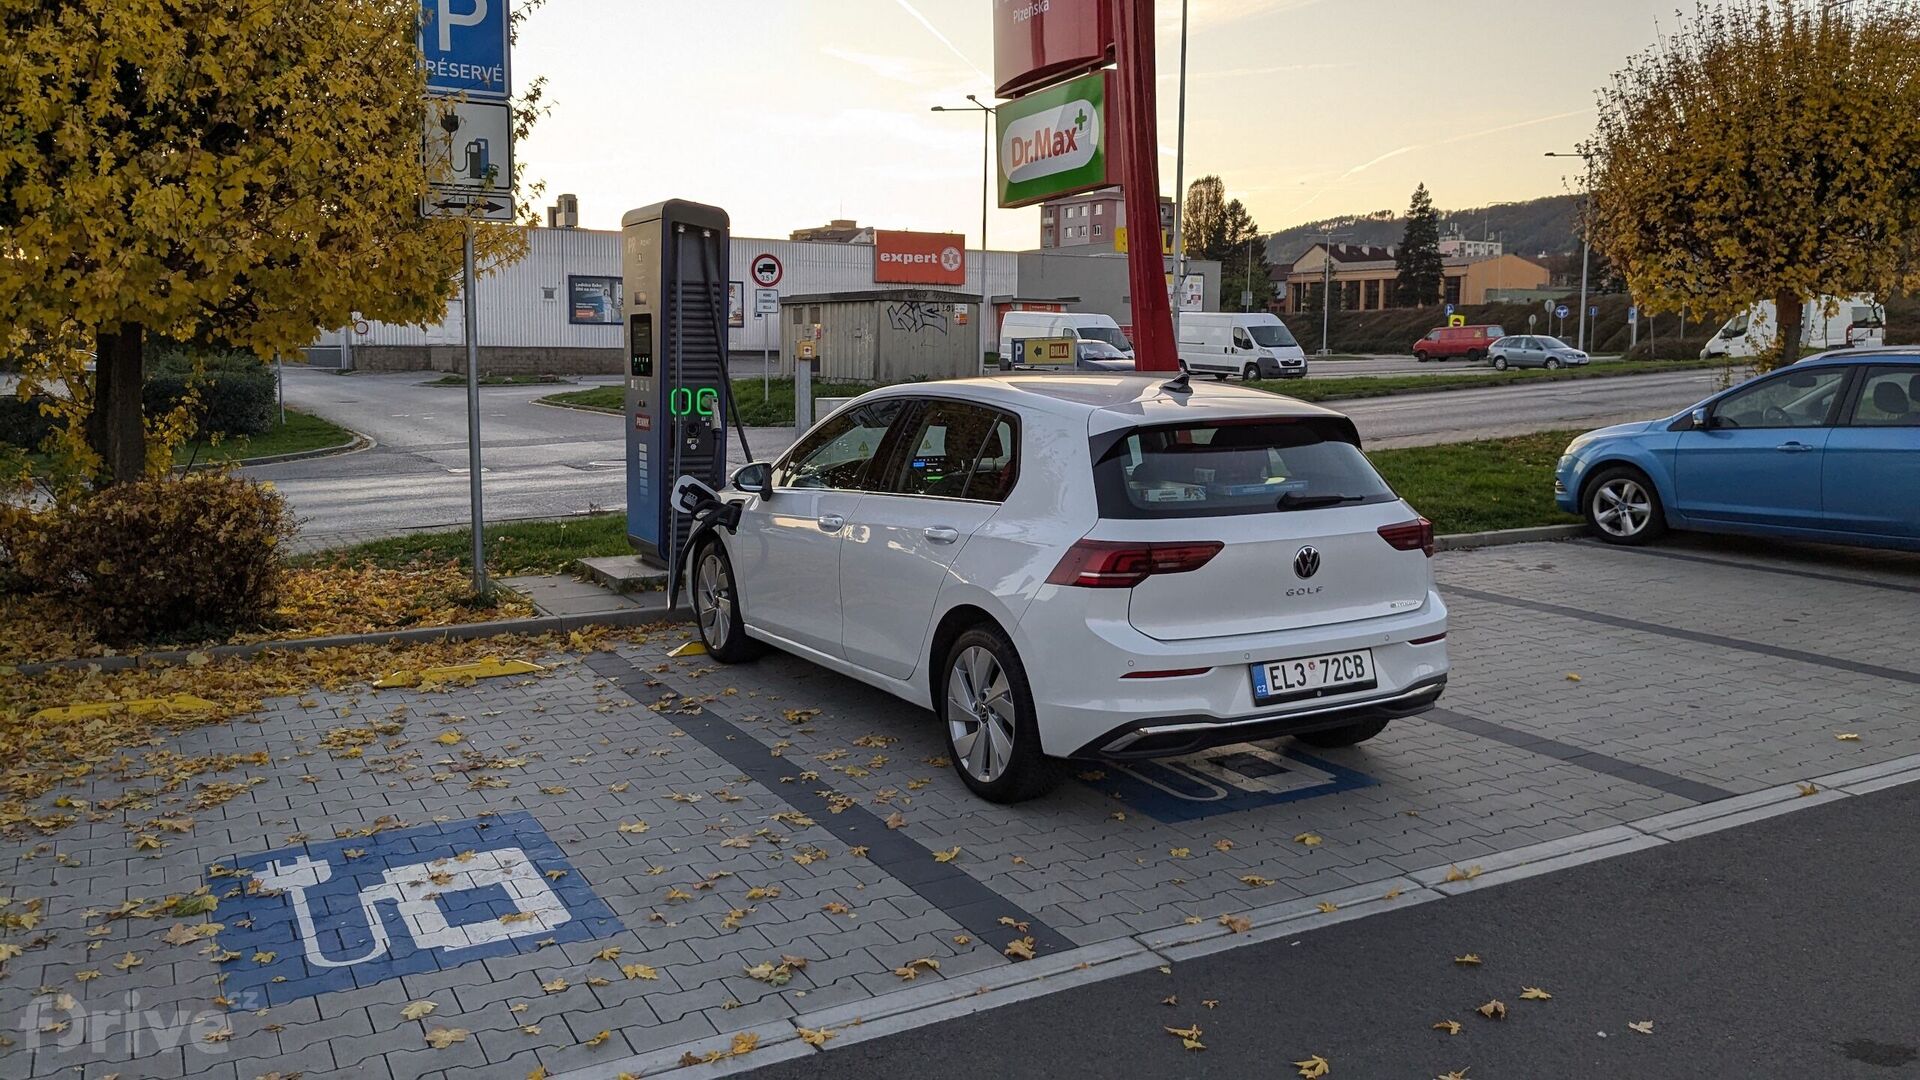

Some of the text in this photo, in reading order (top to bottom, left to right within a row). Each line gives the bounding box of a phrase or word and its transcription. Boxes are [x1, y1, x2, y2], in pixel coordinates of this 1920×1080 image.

[439, 0, 488, 51] P
[426, 58, 503, 82] RÉSERVÉ
[1012, 126, 1078, 168] Dr.Max
[880, 251, 938, 265] expert
[1015, 343, 1068, 361] P BILLA
[1286, 586, 1324, 597] GOLF
[1257, 655, 1365, 693] CZ EL3 72CB
